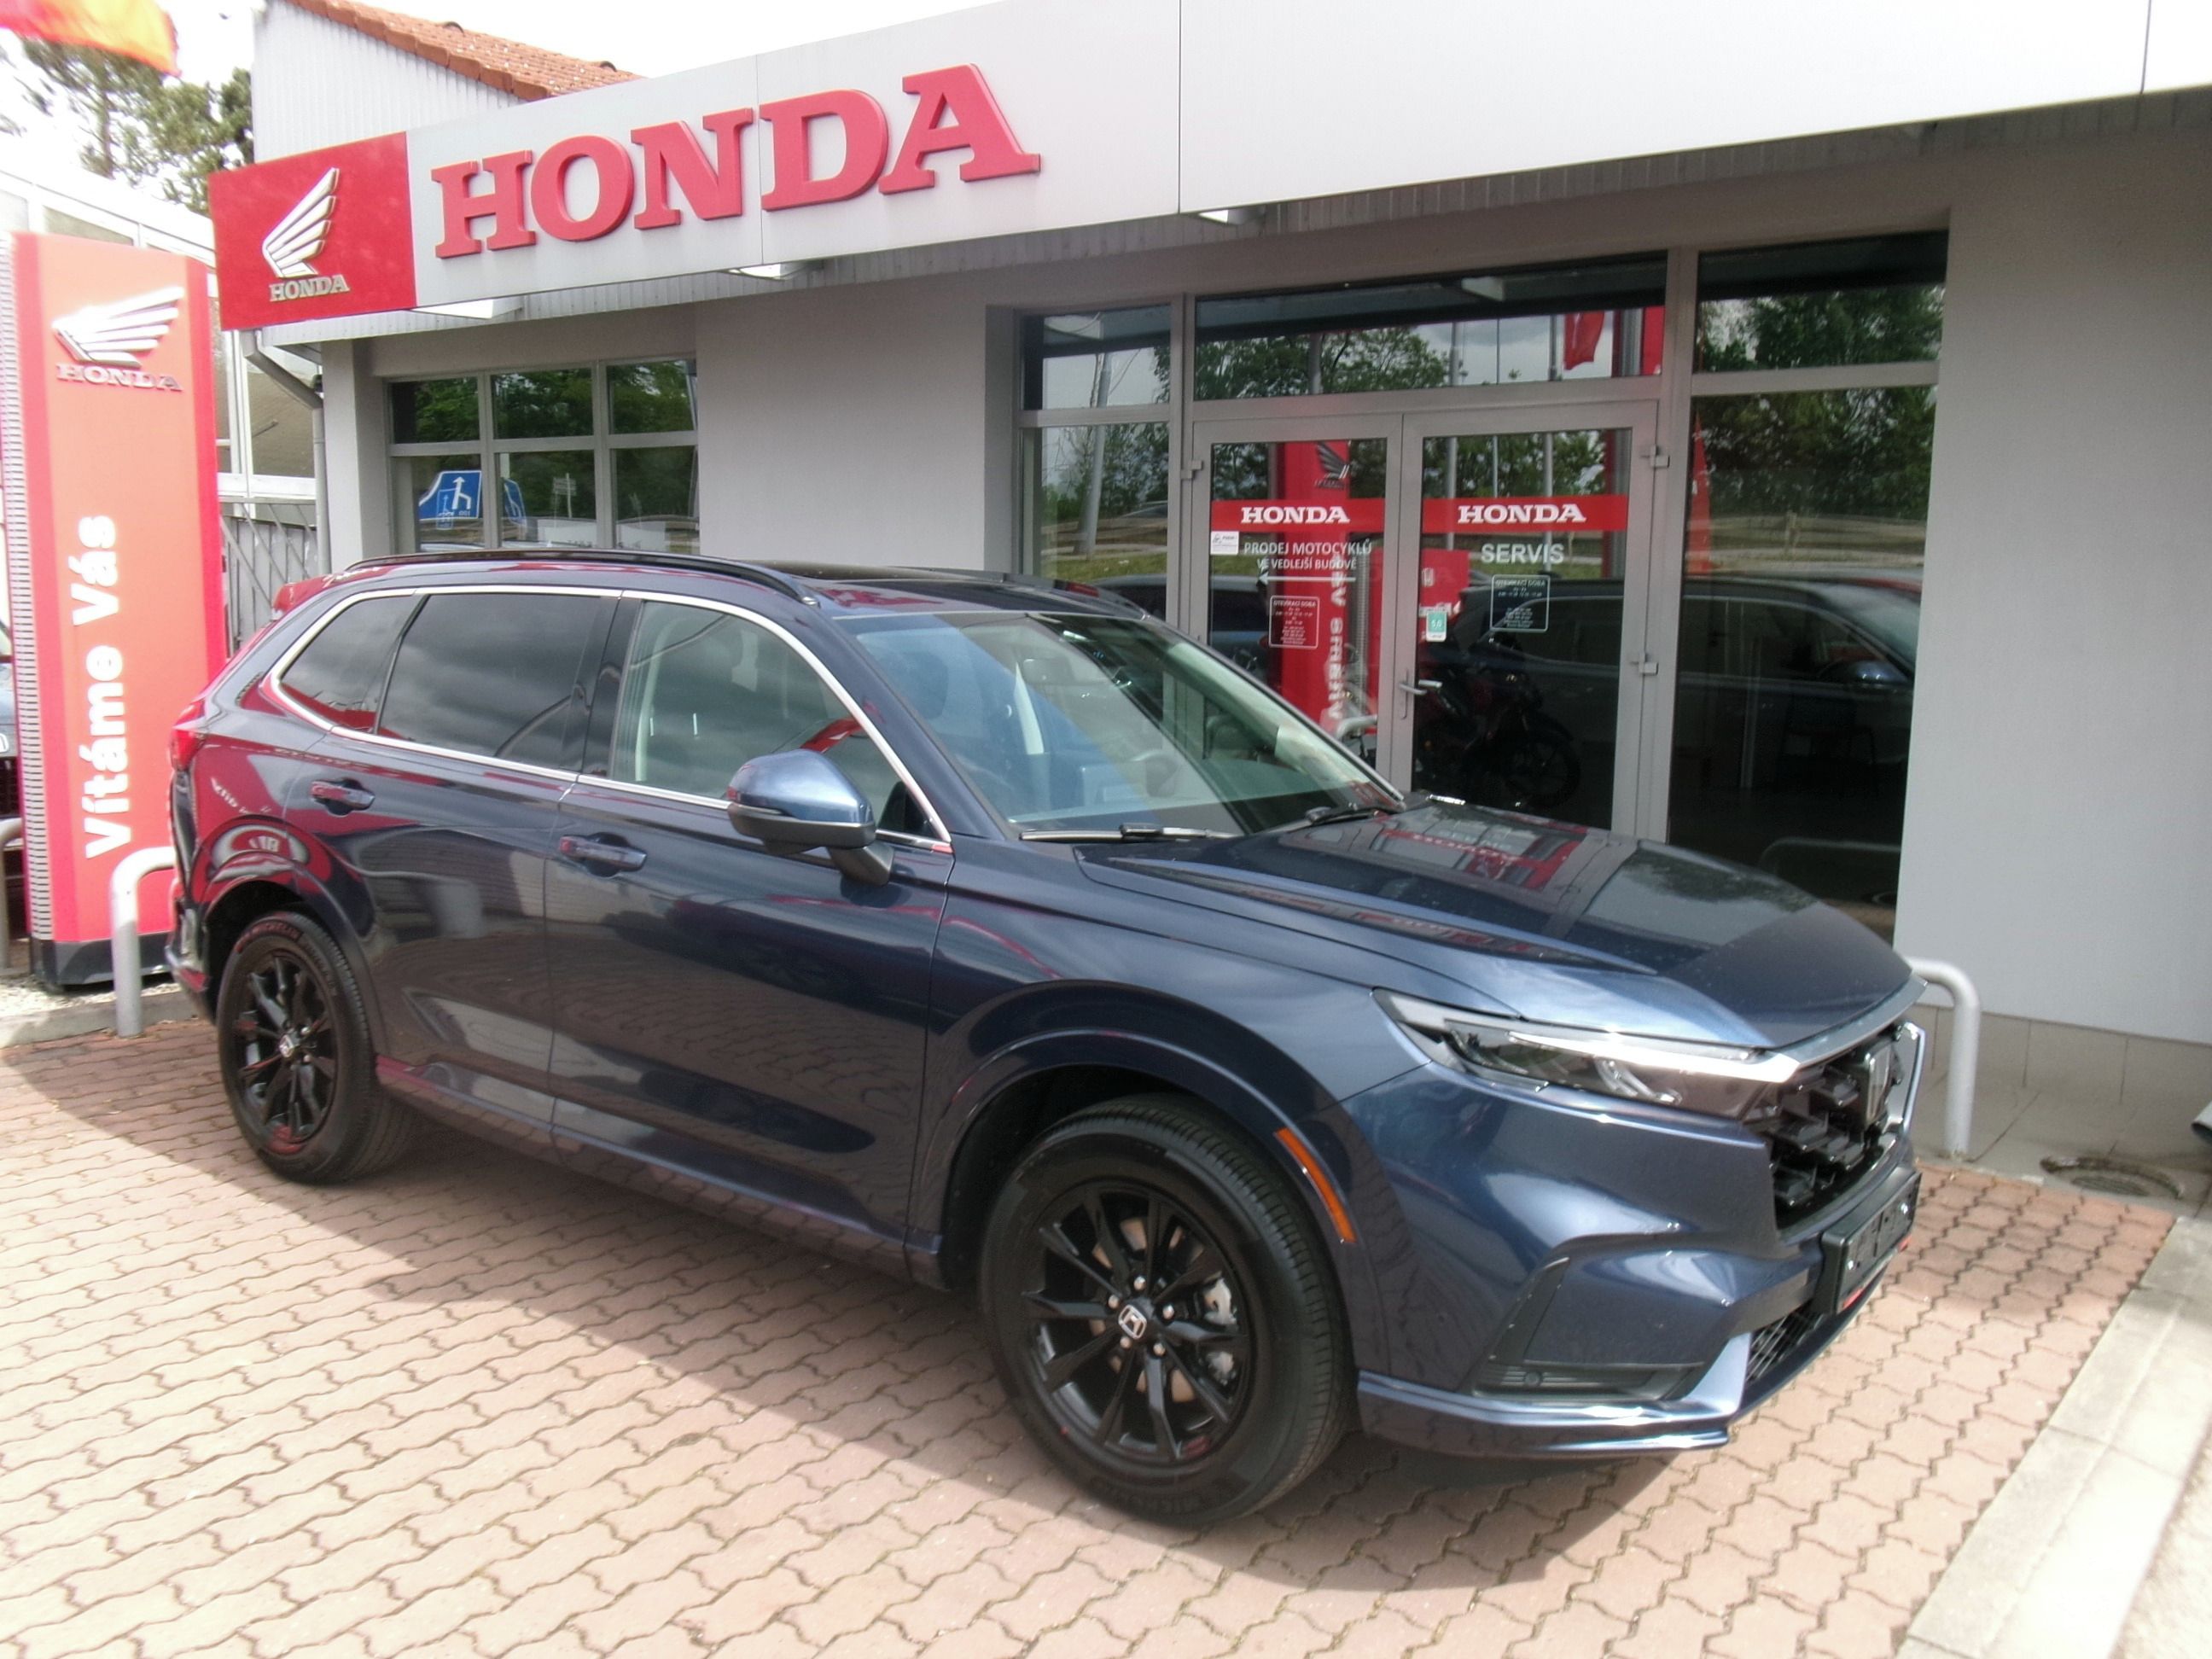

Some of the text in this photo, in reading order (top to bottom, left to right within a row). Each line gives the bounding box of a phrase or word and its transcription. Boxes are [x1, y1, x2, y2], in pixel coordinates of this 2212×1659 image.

[431, 63, 1041, 259] HONDA
[268, 273, 351, 303] HONDA
[55, 363, 183, 393] HONDA
[1241, 506, 1350, 524] HONDA
[1458, 503, 1586, 524] HONDA
[1243, 542, 1289, 556] PRODEJ
[1292, 538, 1372, 556] MOTOCYKLŮ
[1481, 543, 1564, 564] SERVIS
[1256, 556, 1357, 570] VE VEDLEJŠÍ BUDOVĚ
[67, 515, 131, 859] Vítáme Vás
